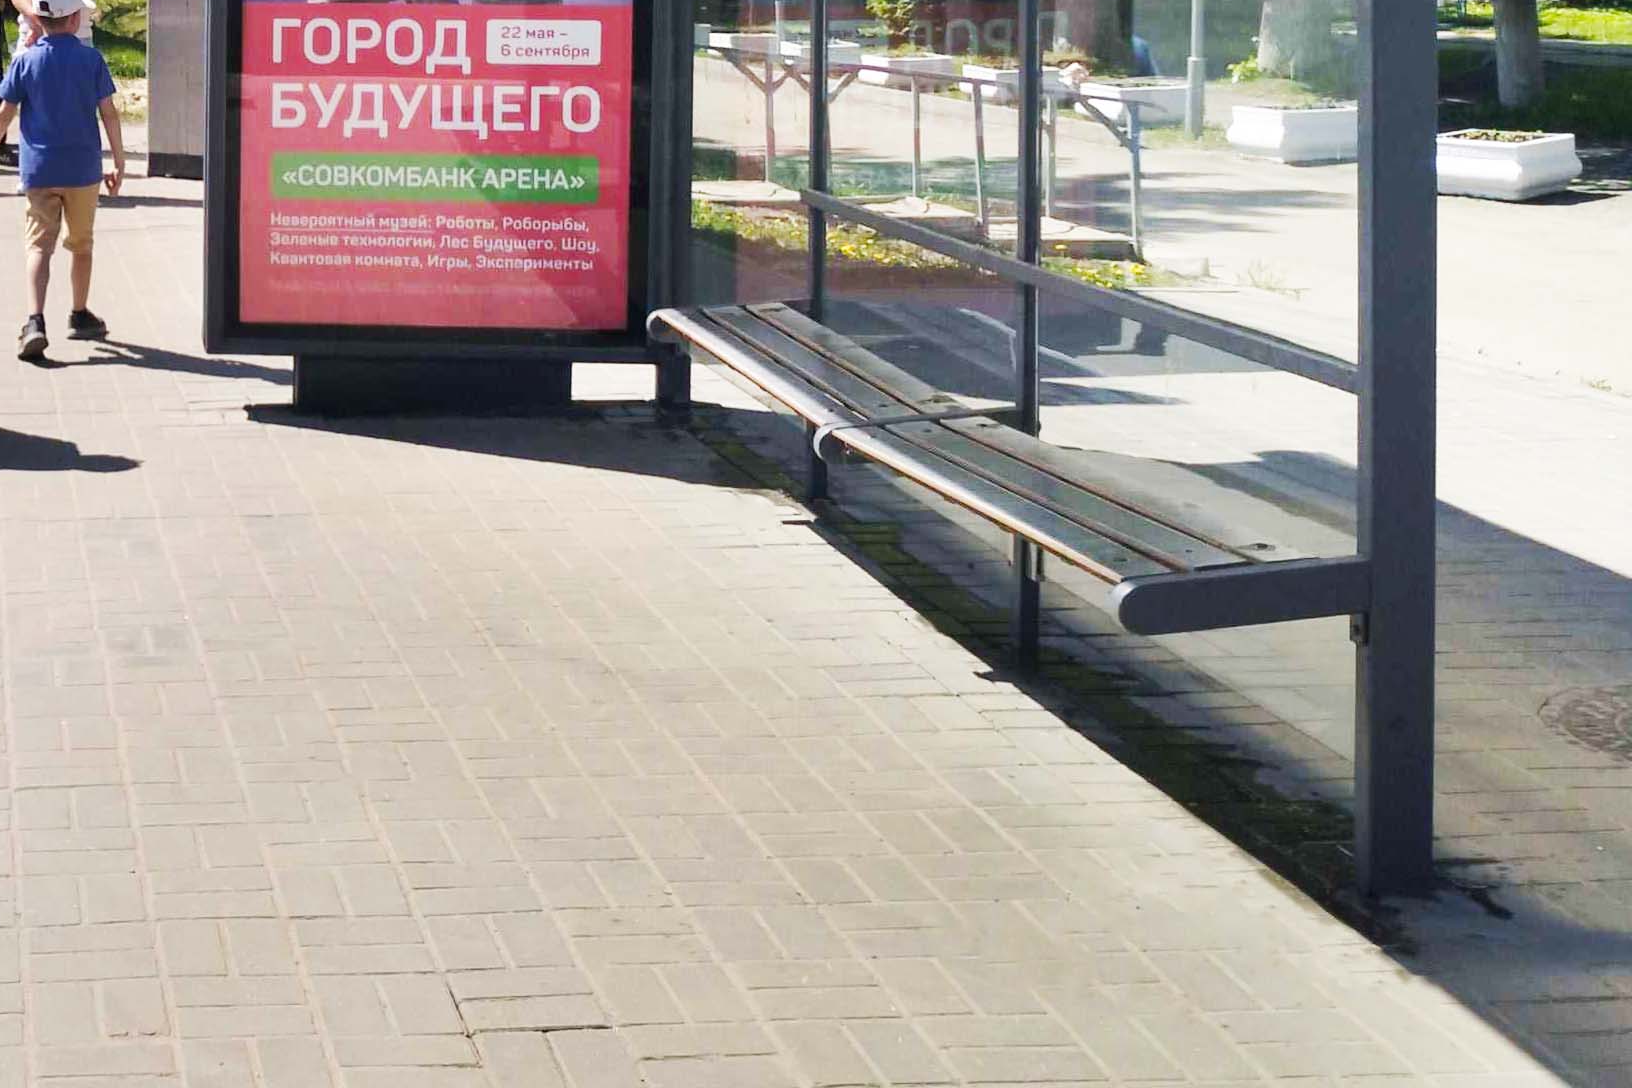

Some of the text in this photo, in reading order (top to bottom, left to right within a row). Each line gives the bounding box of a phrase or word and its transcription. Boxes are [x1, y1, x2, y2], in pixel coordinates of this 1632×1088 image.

[501, 26, 521, 39] 22
[526, 30, 555, 39] мая
[272, 18, 471, 75] ГОРОД
[500, 44, 590, 60] 6 сентября
[272, 83, 601, 140] БУДУЩЕГО
[281, 165, 585, 190] «СОВКОМБАНК АРЕНА»
[270, 212, 590, 233] Невероятный музей: Роботы, Роборыбы,
[440, 235, 468, 248] Лес
[270, 251, 351, 265] Квантовая
[355, 254, 423, 269] комната,
[476, 255, 593, 272] Эксперименты
